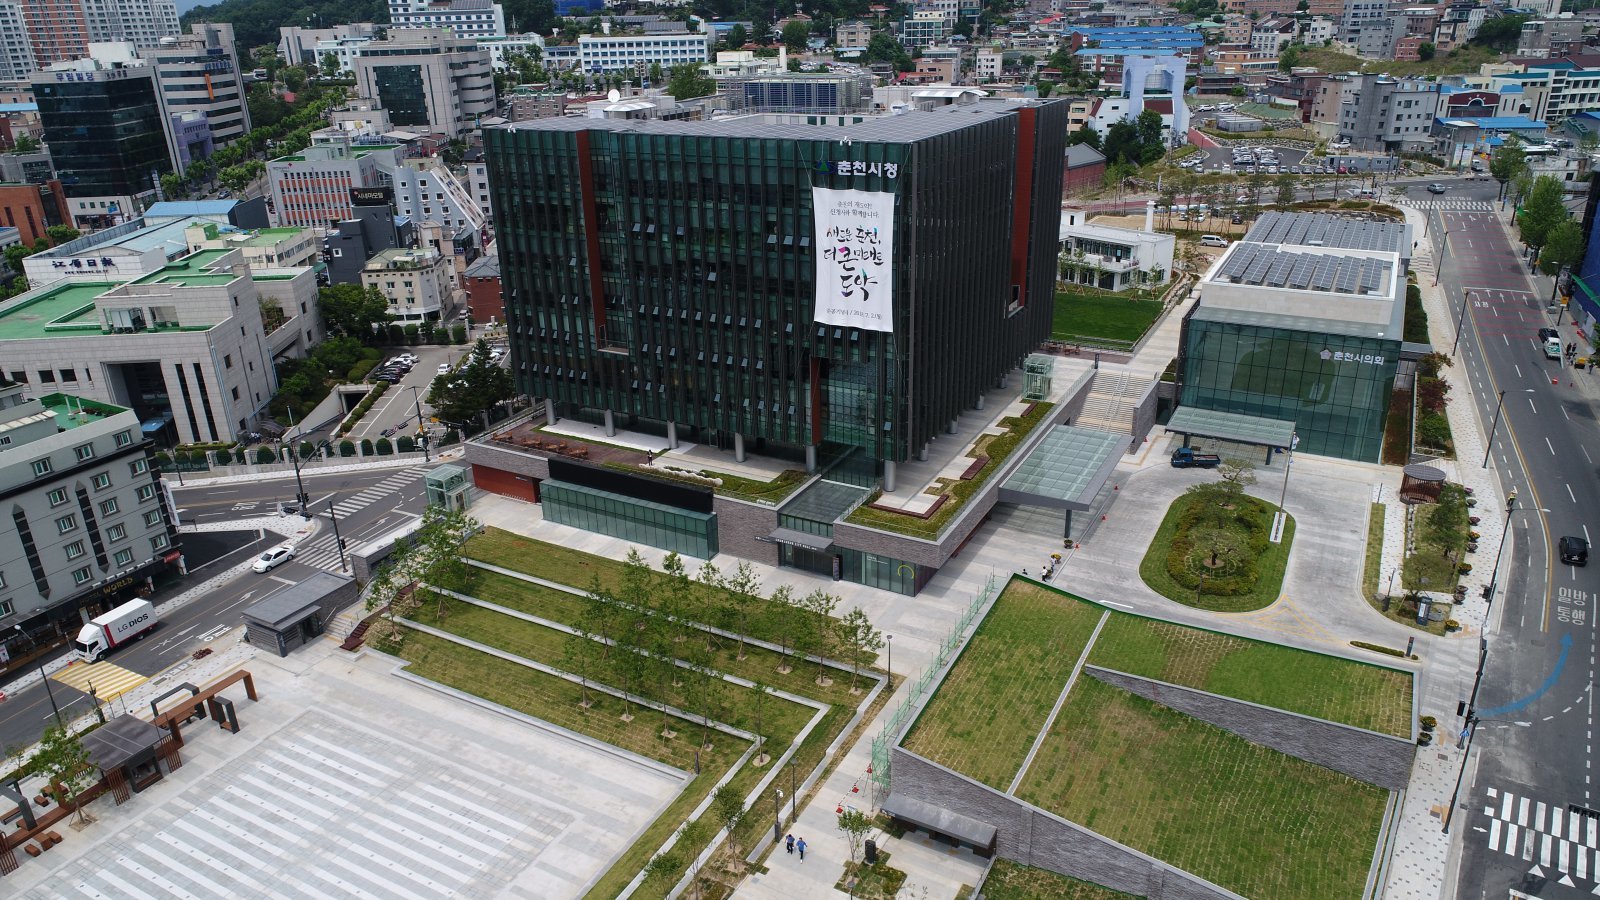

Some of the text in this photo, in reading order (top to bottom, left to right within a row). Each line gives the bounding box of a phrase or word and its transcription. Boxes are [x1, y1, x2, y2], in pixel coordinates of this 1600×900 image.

[56, 72, 95, 82] 무림빌딩
[837, 160, 898, 179] 춘천시청
[826, 225, 853, 242] 새로운
[823, 246, 837, 261] 더
[837, 246, 859, 271] 큰
[839, 268, 879, 302] 도약
[1333, 351, 1385, 366] 춘천시의회
[103, 577, 133, 594] WORLD
[1558, 586, 1588, 606] 일방
[117, 613, 149, 633] LG DIOS
[1557, 605, 1586, 626] 통행
